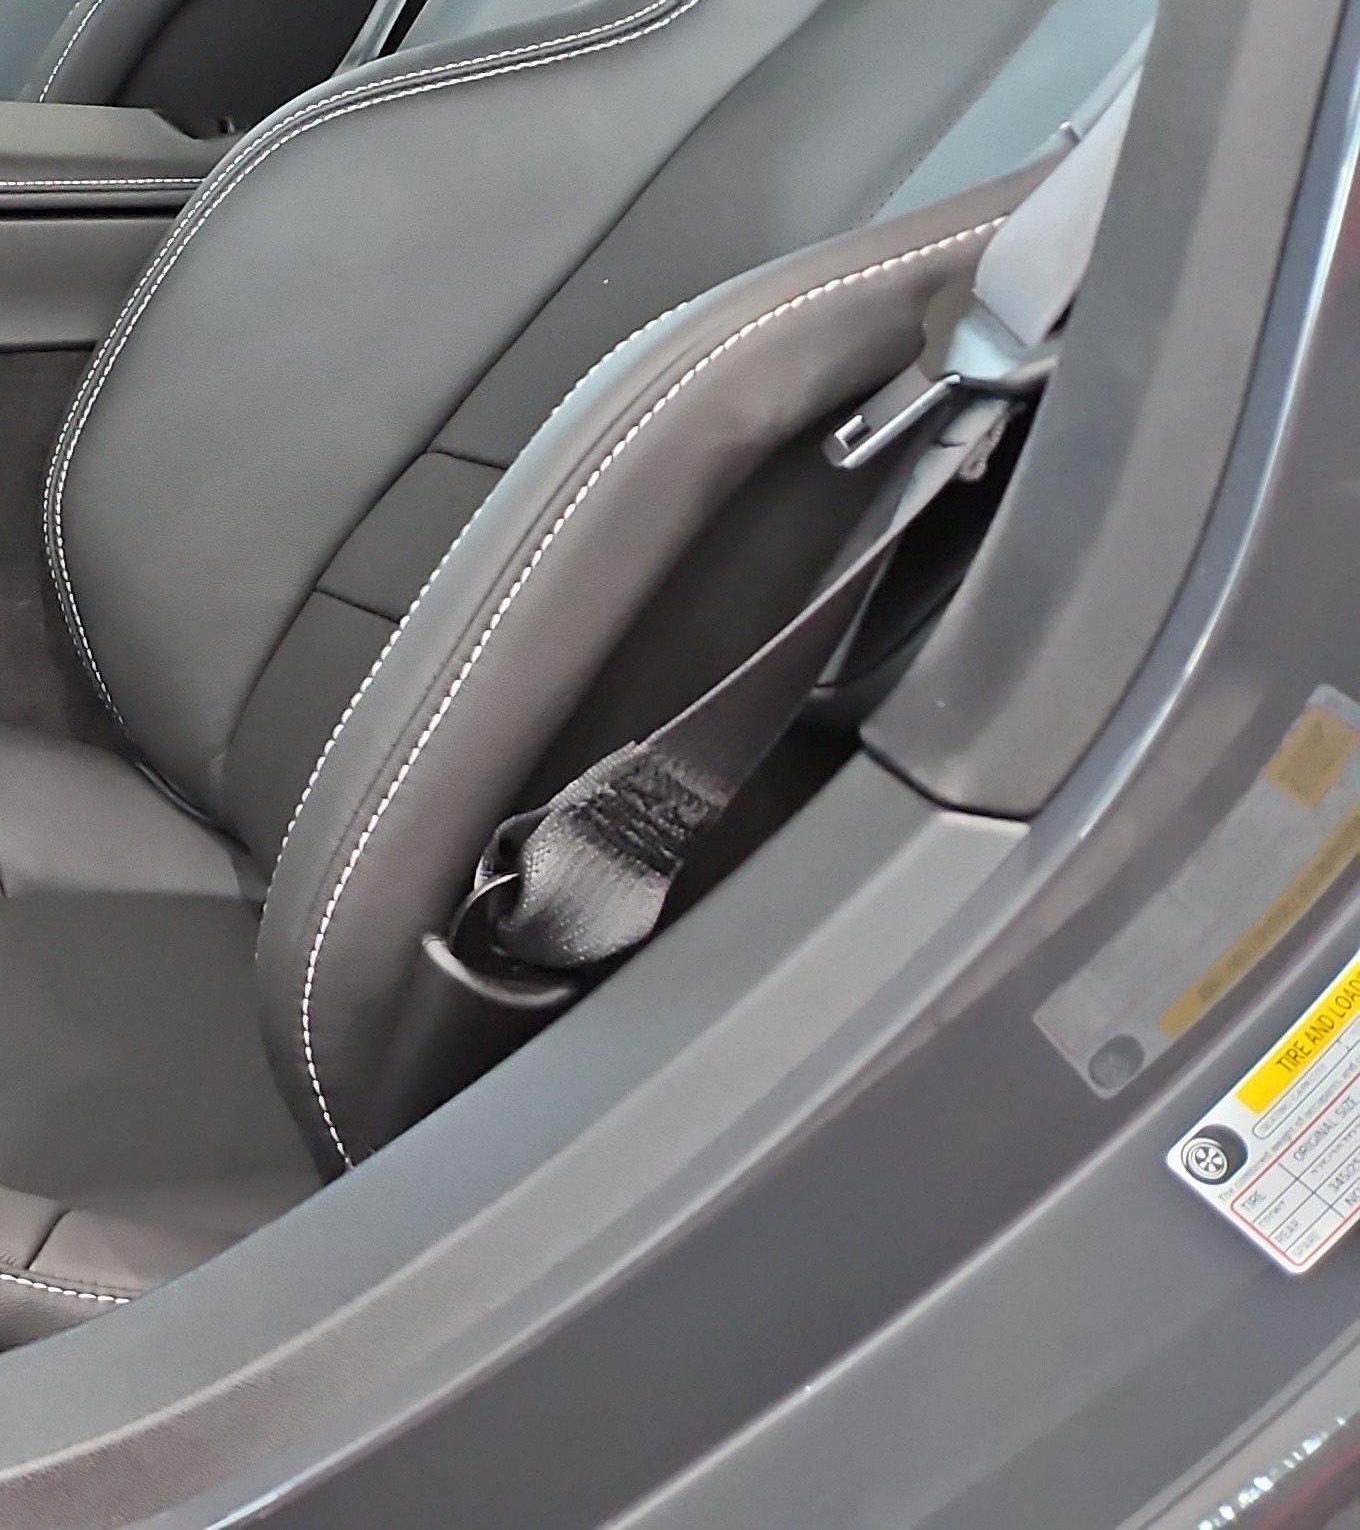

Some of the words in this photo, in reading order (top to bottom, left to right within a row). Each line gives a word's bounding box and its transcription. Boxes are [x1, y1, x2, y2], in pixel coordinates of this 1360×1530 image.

[1276, 1040, 1311, 1072] TIRE
[1305, 1015, 1334, 1045] AND
[1293, 1120, 1339, 1162] ORIGINAL
[1335, 1096, 1358, 1119] SIZE
[1241, 1190, 1266, 1212] TIRE
